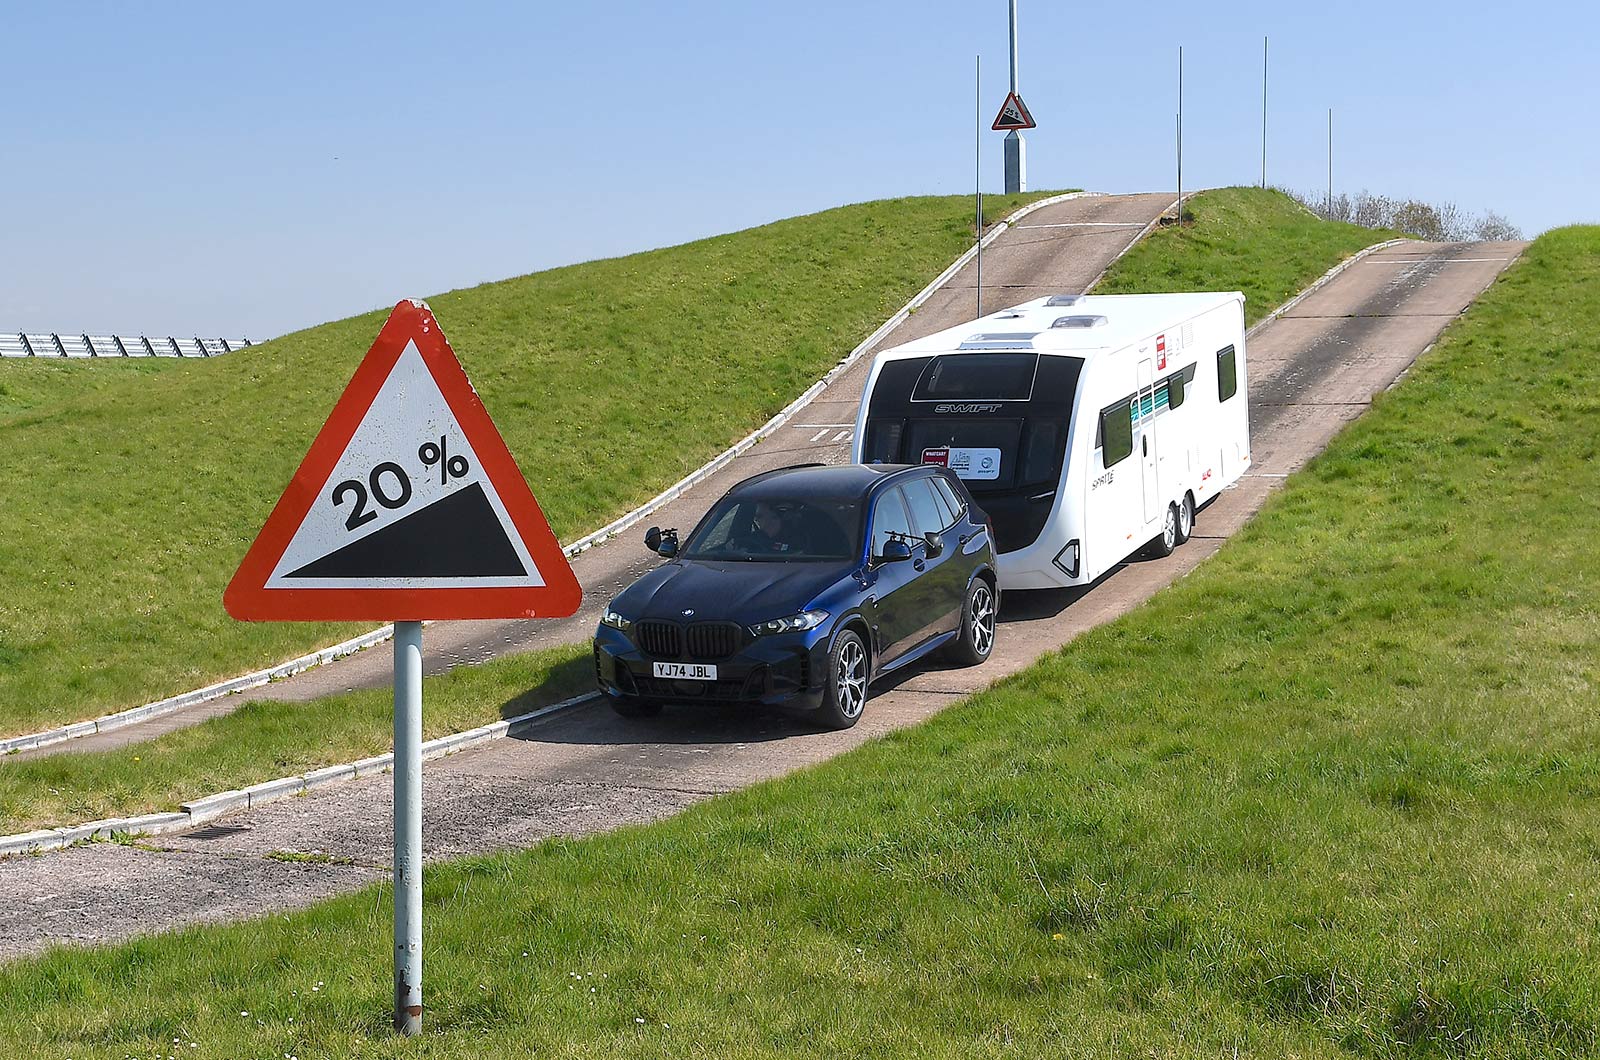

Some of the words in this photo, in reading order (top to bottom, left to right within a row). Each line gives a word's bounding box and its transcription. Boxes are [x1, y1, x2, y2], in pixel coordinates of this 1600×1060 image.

[934, 403, 1003, 413] SWIFT
[657, 664, 686, 677] YJ74
[689, 666, 711, 678] JBL
